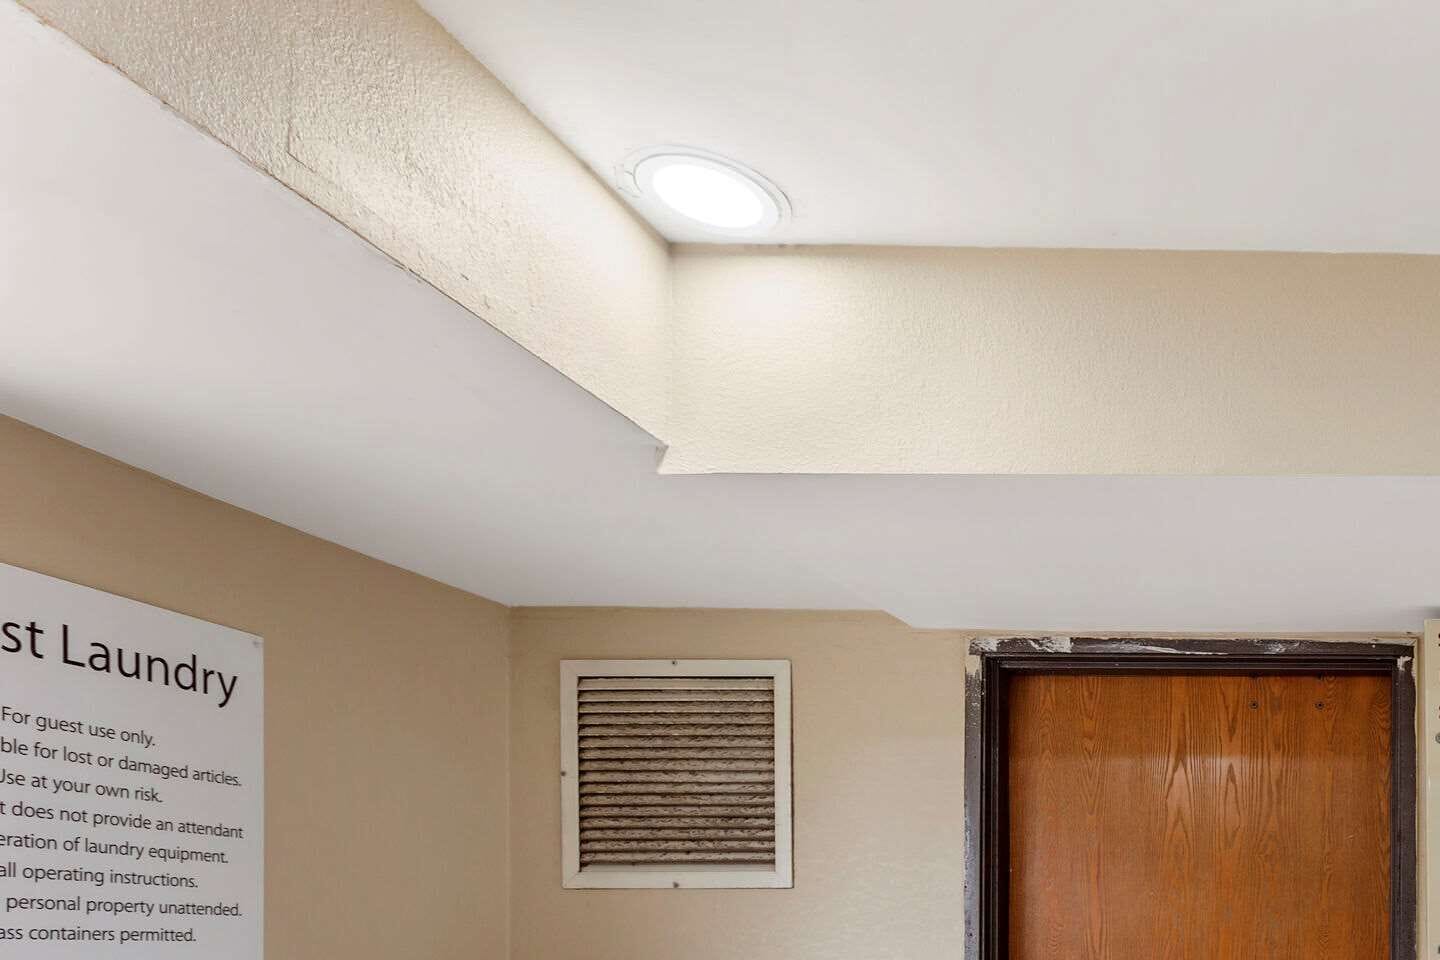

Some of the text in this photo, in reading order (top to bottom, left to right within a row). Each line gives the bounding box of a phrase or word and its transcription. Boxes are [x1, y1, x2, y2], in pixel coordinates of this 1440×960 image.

[1, 621, 238, 708] st Laundry
[1, 705, 155, 749] For guest use only.
[1, 736, 242, 787] ble for lost or damaged articles.
[31, 776, 49, 789] at
[53, 779, 91, 794] your
[95, 784, 130, 799] own
[134, 787, 163, 803] risk.
[12, 801, 54, 820] does
[60, 809, 89, 823] not
[93, 813, 152, 829] provide
[155, 820, 174, 832] an
[178, 823, 245, 839] attendant
[63, 837, 81, 852] of
[85, 838, 144, 861] laundry
[148, 846, 229, 864] equipment.
[0, 861, 199, 888] all operating instructions.
[7, 895, 243, 917] personal property unattended.
[28, 926, 116, 941] containers
[120, 928, 197, 945] permitted.
